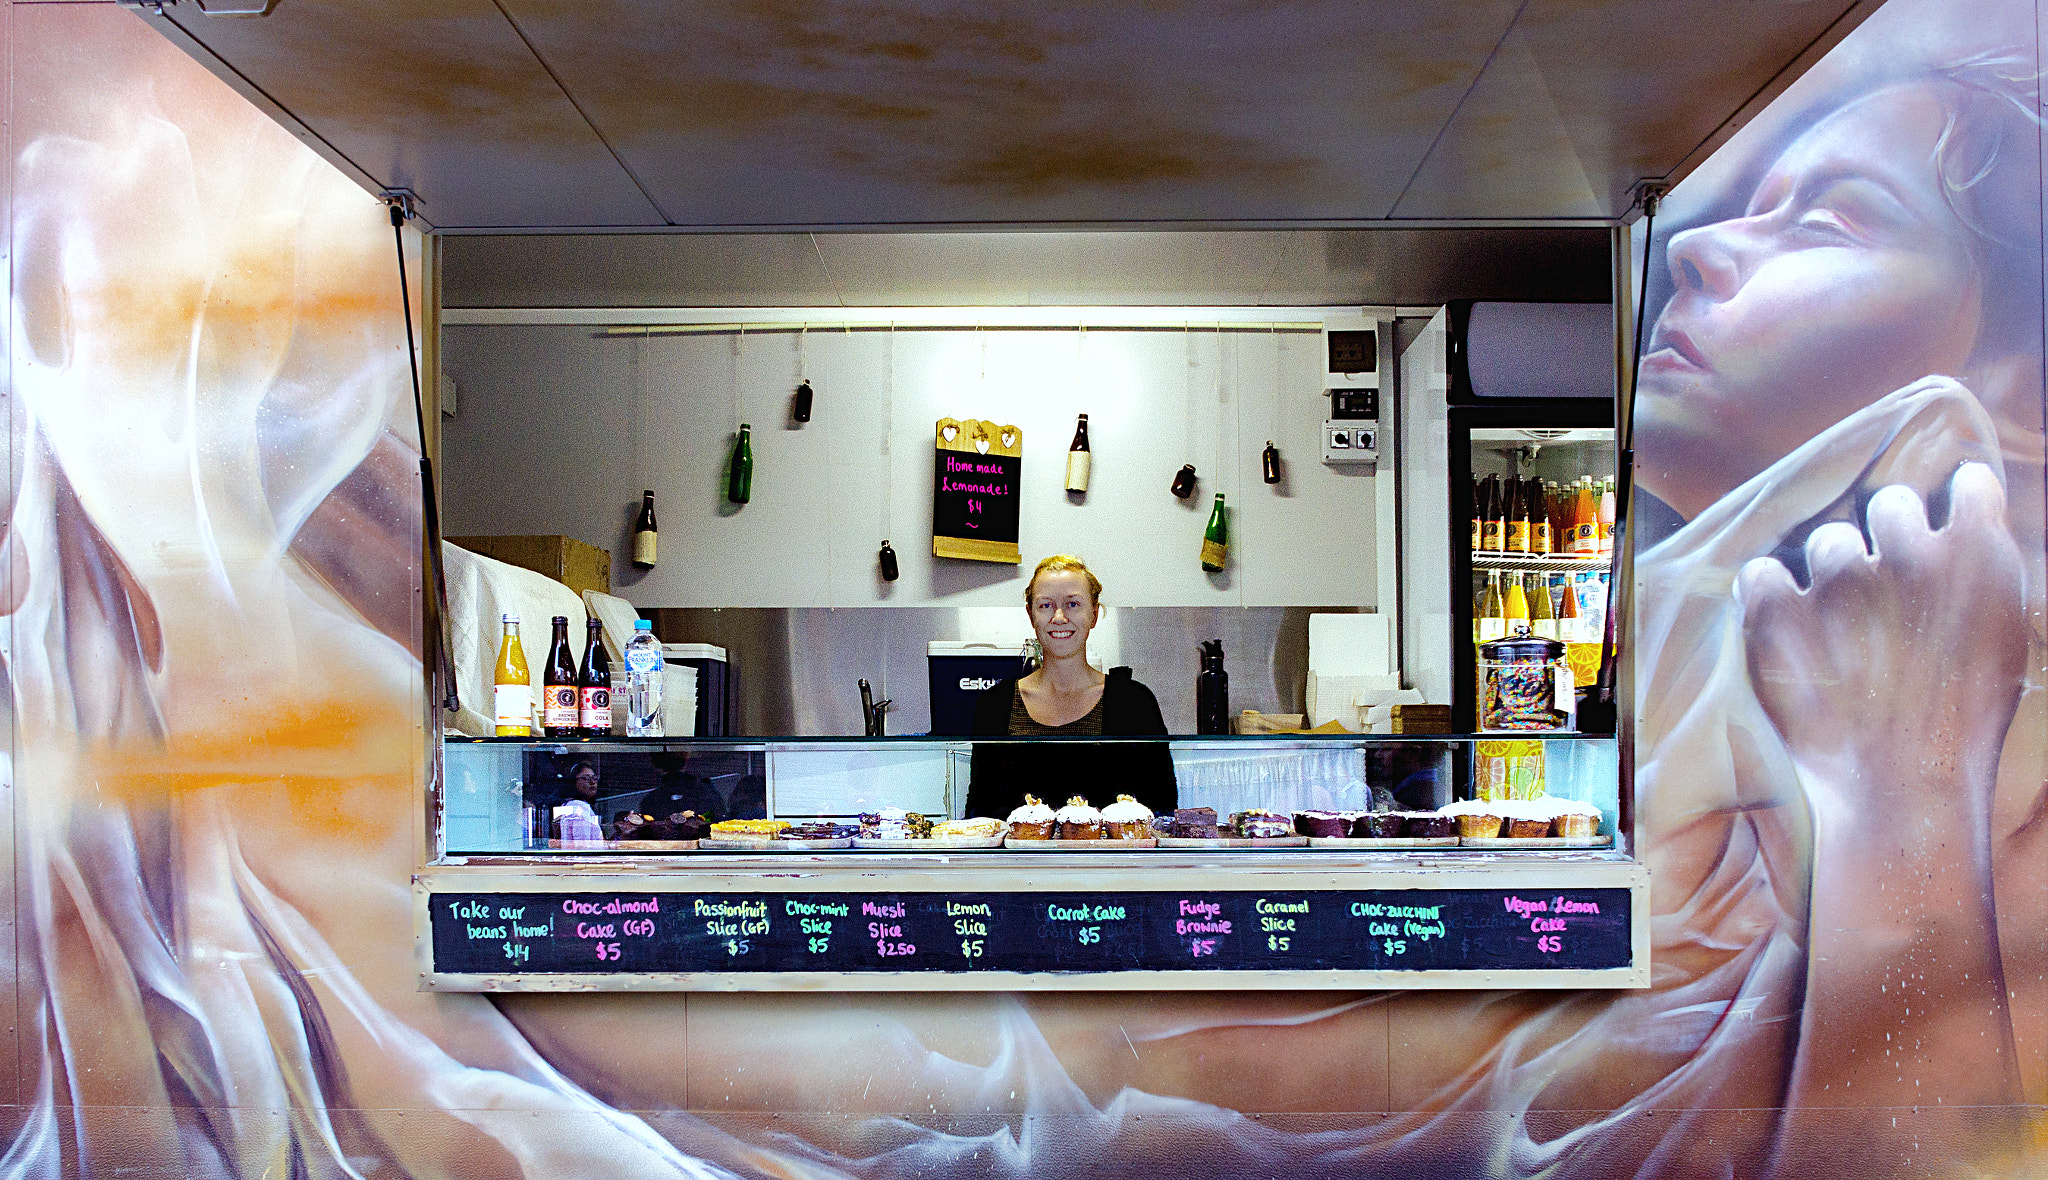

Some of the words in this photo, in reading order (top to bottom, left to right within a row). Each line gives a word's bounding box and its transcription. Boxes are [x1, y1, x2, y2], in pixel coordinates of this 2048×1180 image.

[947, 457, 973, 472] Home
[977, 464, 1003, 474] made
[943, 477, 1008, 495] Lemonade!
[968, 499, 981, 513] $4
[960, 677, 996, 690] Esky
[449, 901, 489, 919] Take
[499, 907, 525, 919] our
[563, 897, 659, 915] Choc-almond
[693, 899, 767, 919] Passionfruit
[786, 901, 849, 916] Choc-mint
[862, 902, 905, 918] Muesli
[947, 901, 991, 916] Lemon
[1048, 903, 1090, 922] Carrot
[1093, 906, 1126, 920] Cake
[1178, 900, 1222, 921] Fudge
[1256, 899, 1309, 914] Caramel
[1504, 896, 1547, 919] Vegan
[1553, 896, 1600, 914] Lemon
[467, 924, 507, 939] beans
[511, 916, 554, 937] home!
[577, 922, 616, 938] Cake
[623, 919, 655, 937] (GF)
[705, 920, 738, 935] Slice
[741, 918, 769, 936] (GF)
[800, 918, 832, 934] Slice
[868, 922, 902, 940] Slice
[954, 919, 987, 935] Slice
[1176, 918, 1231, 935] Brownie
[1261, 917, 1296, 931] Slice
[1369, 922, 1398, 936] Cake
[1402, 918, 1445, 942] (Vegan)
[1529, 915, 1569, 932] Cake
[809, 936, 829, 953] $5
[1079, 927, 1100, 945] $5
[1268, 935, 1290, 951] $5
[1537, 935, 1561, 953] $5
[503, 942, 529, 963] $14
[596, 942, 621, 960] $5
[725, 939, 749, 956] $5
[961, 939, 983, 958] $5
[1192, 938, 1215, 957] $5
[1384, 938, 1406, 956] $5
